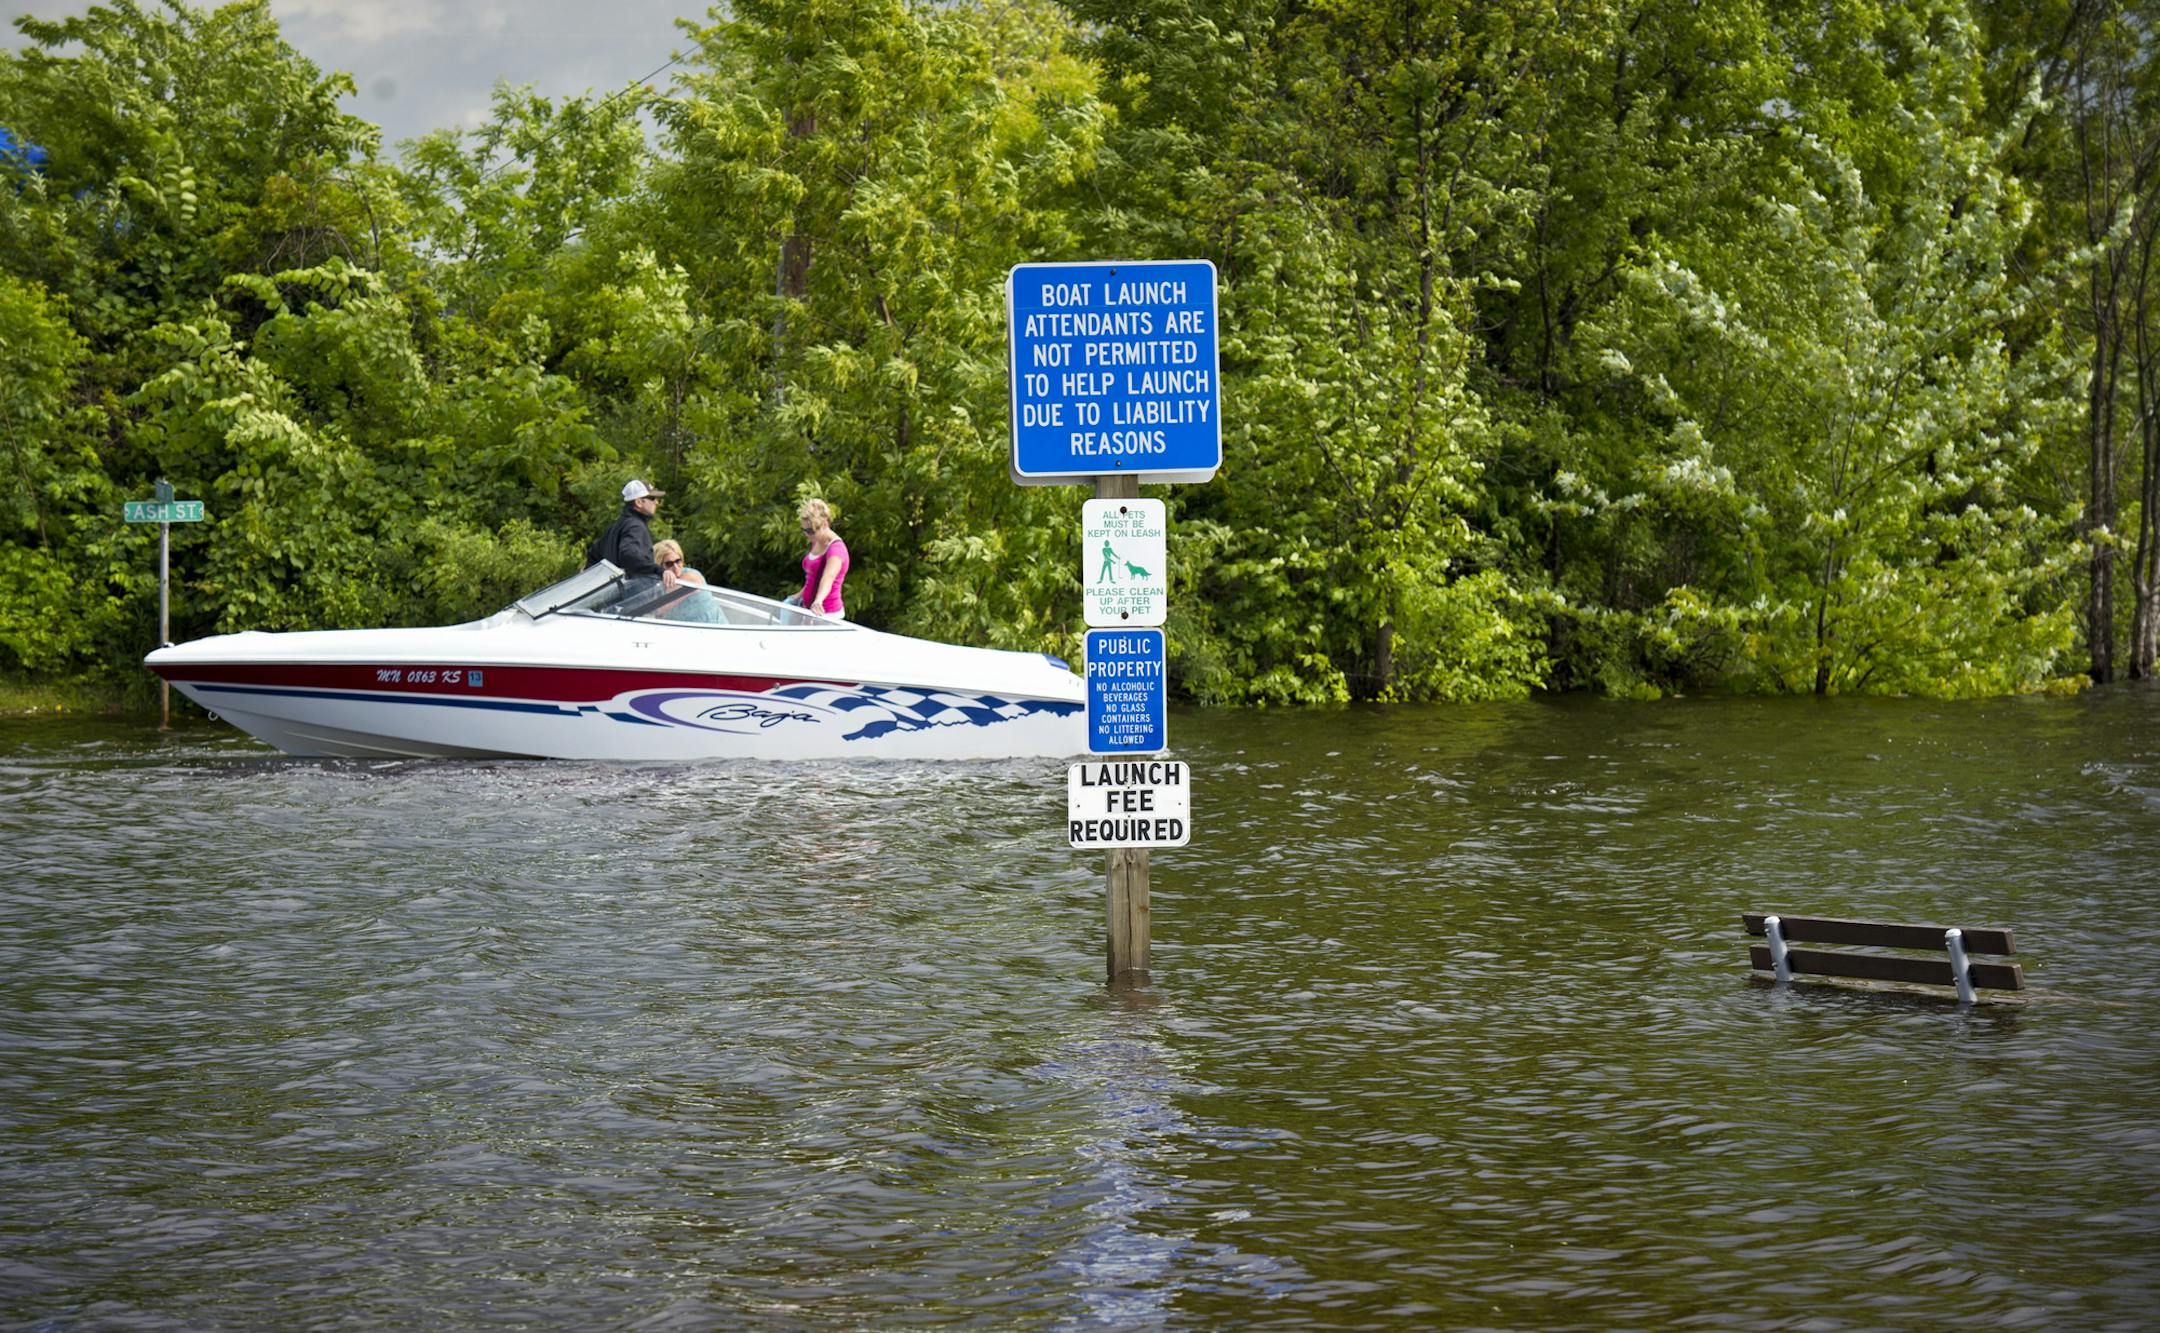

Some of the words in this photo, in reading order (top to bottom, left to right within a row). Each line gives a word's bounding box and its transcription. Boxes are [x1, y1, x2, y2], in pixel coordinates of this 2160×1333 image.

[1042, 283, 1091, 307] BOAT
[1104, 282, 1186, 305] LAUNCH
[1025, 312, 1153, 337] ATTENDANTS
[1165, 311, 1205, 334] ARE
[1033, 343, 1072, 367] NOT
[1085, 341, 1198, 366] PERMITTED
[1024, 374, 1049, 397] TO
[1062, 372, 1115, 396] HELP
[1127, 370, 1209, 395] LAUNCH
[1023, 403, 1064, 427] DUE
[1075, 402, 1100, 426] TO
[1113, 400, 1210, 425] LIABILITY
[1071, 431, 1166, 456] REASONS
[133, 504, 169, 520] ASH
[175, 504, 196, 519] ST
[1103, 511, 1119, 519] ALL
[1104, 520, 1129, 528] MUST
[1133, 520, 1145, 528] BE
[1088, 529, 1111, 538] KEPT
[1115, 529, 1128, 538] ON
[1131, 529, 1161, 537] LEASH
[1086, 588, 1125, 596] PLEASE
[1129, 587, 1164, 596] CLEAN
[1100, 597, 1113, 606] UP
[1117, 597, 1150, 605] AFTER
[1099, 606, 1127, 615] YOUR
[1132, 606, 1151, 614] PET
[1098, 638, 1151, 655] PUBLIC
[376, 669, 402, 683] MN
[407, 670, 437, 683] 0863
[441, 670, 462, 683] KS
[1088, 661, 1162, 677] PROPERTY
[1096, 682, 1108, 692] NO
[1111, 682, 1155, 691] ALCOHOLIC
[1103, 692, 1148, 703] BEVERAGES
[696, 703, 821, 728] Baja
[1106, 703, 1117, 713] NO
[1121, 703, 1146, 712] GLASS
[1101, 714, 1151, 724] CONTAINERS
[1098, 725, 1110, 734] NO
[1113, 724, 1154, 734] LITTERING
[1108, 735, 1145, 745] ALLOWED
[1081, 763, 1180, 786] LAUNCH
[1106, 790, 1154, 812] FEE
[1070, 819, 1183, 842] REQUIRED
